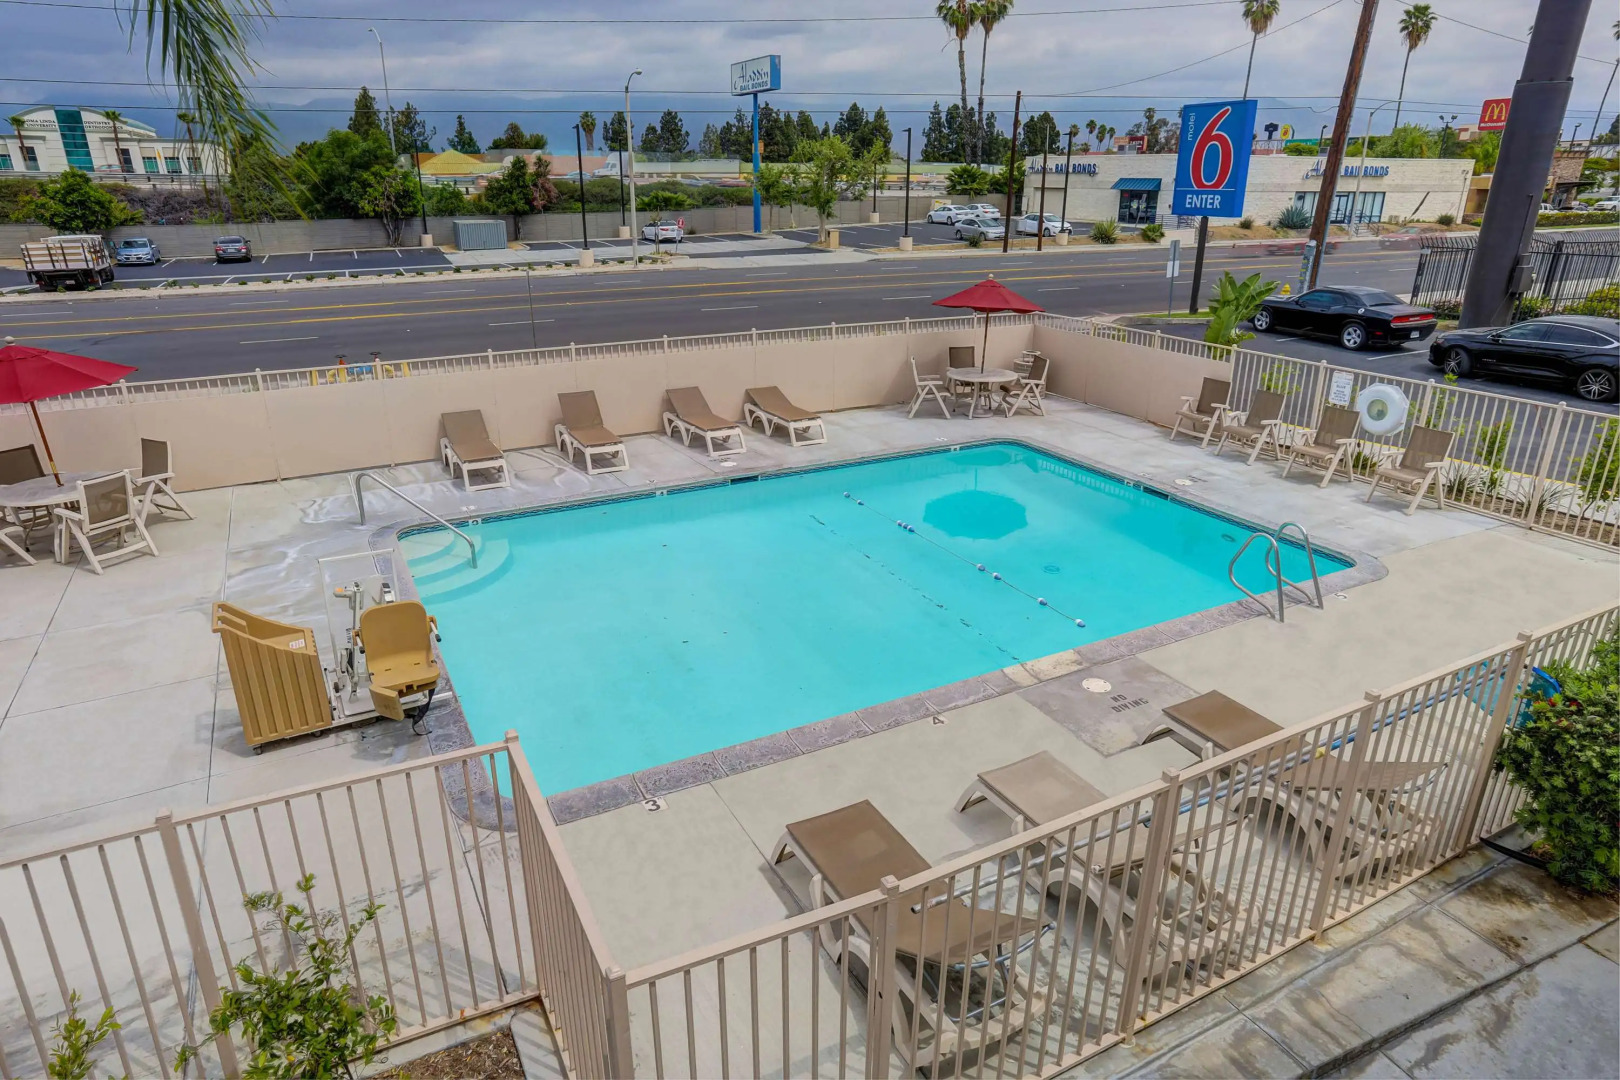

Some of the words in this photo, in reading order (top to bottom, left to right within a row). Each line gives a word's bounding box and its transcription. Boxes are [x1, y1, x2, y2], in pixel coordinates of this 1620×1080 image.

[740, 83, 751, 91] BAIL
[751, 80, 769, 89] BONDS
[1188, 112, 1196, 141] motel
[1190, 105, 1234, 190] 6
[1072, 163, 1097, 174] BONDS
[1363, 165, 1390, 176] BONDS
[1185, 194, 1221, 209] ENTER
[1110, 694, 1127, 703] NO
[1111, 697, 1149, 713] DIVING
[933, 716, 945, 725] 4
[644, 799, 661, 812] 3
